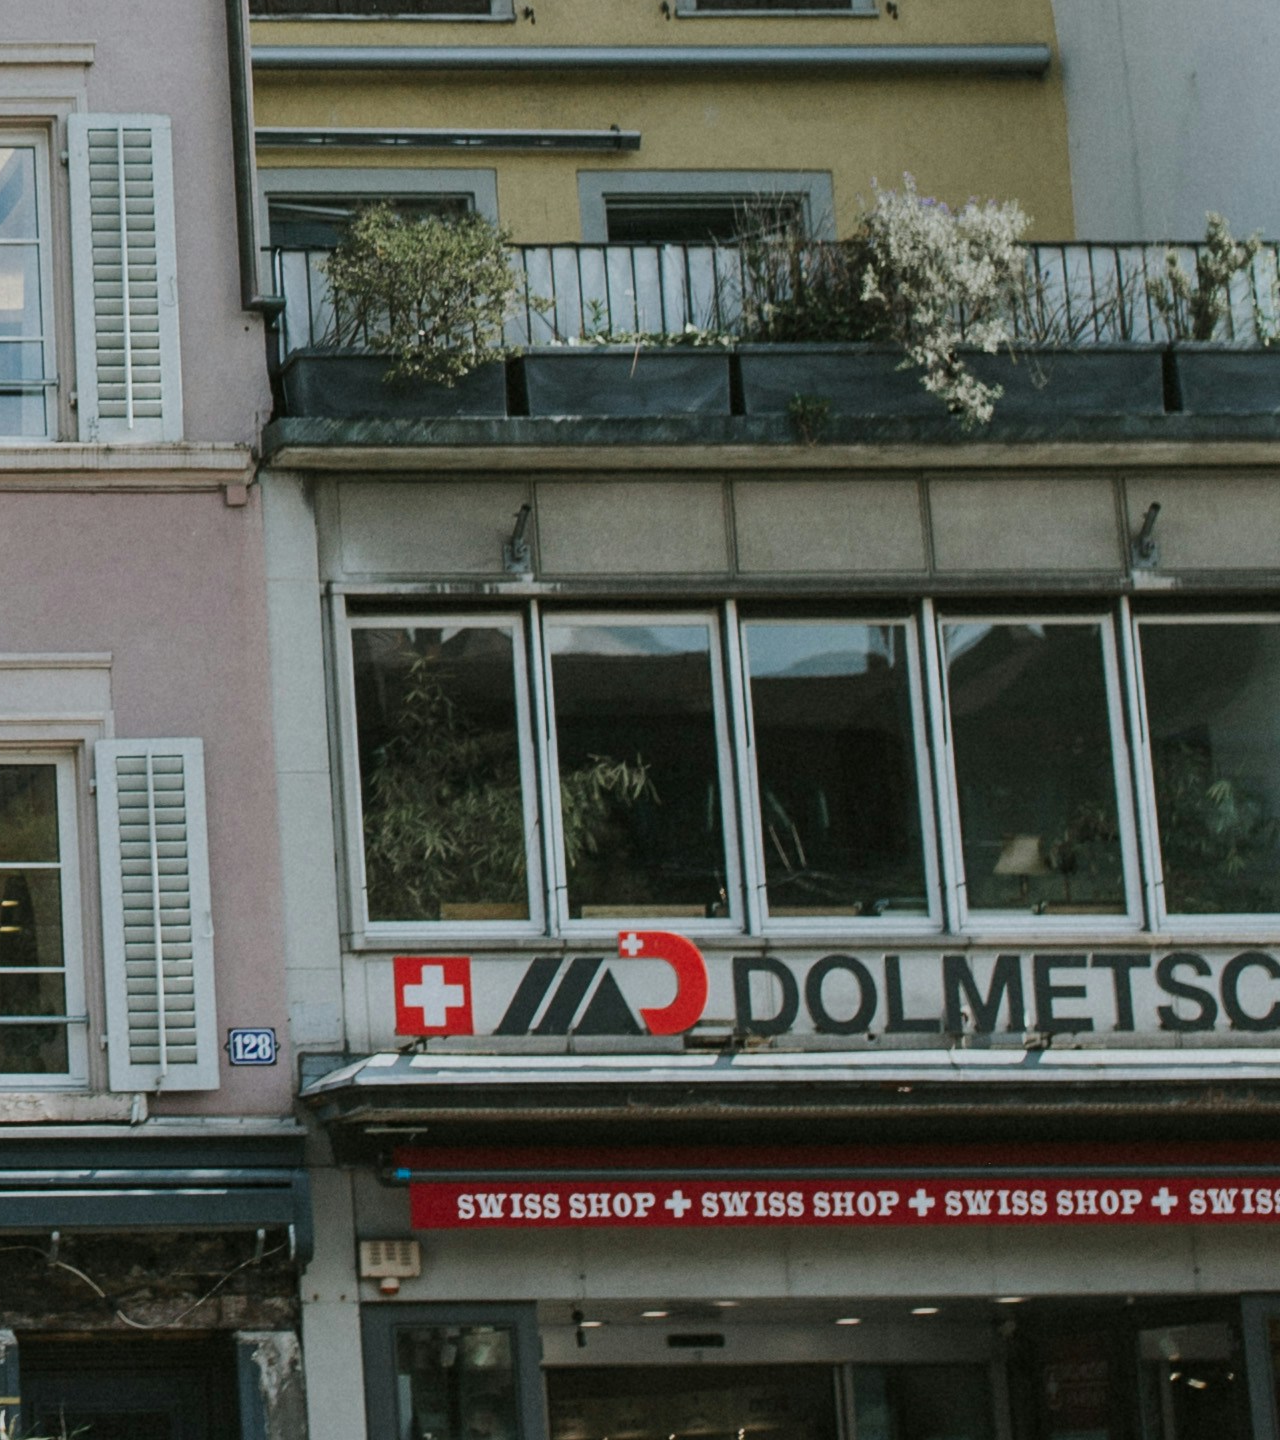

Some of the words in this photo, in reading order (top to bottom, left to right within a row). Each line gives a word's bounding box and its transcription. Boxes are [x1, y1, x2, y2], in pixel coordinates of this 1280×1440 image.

[732, 951, 1280, 1036] DOLMETSC
[233, 1033, 272, 1060] 128
[457, 1192, 561, 1219] SWISS
[568, 1191, 656, 1218] SHOP
[701, 1190, 805, 1218] SWISS
[812, 1190, 900, 1217] SHOP
[944, 1189, 1048, 1217] SWISS
[1055, 1188, 1143, 1216] SHOP
